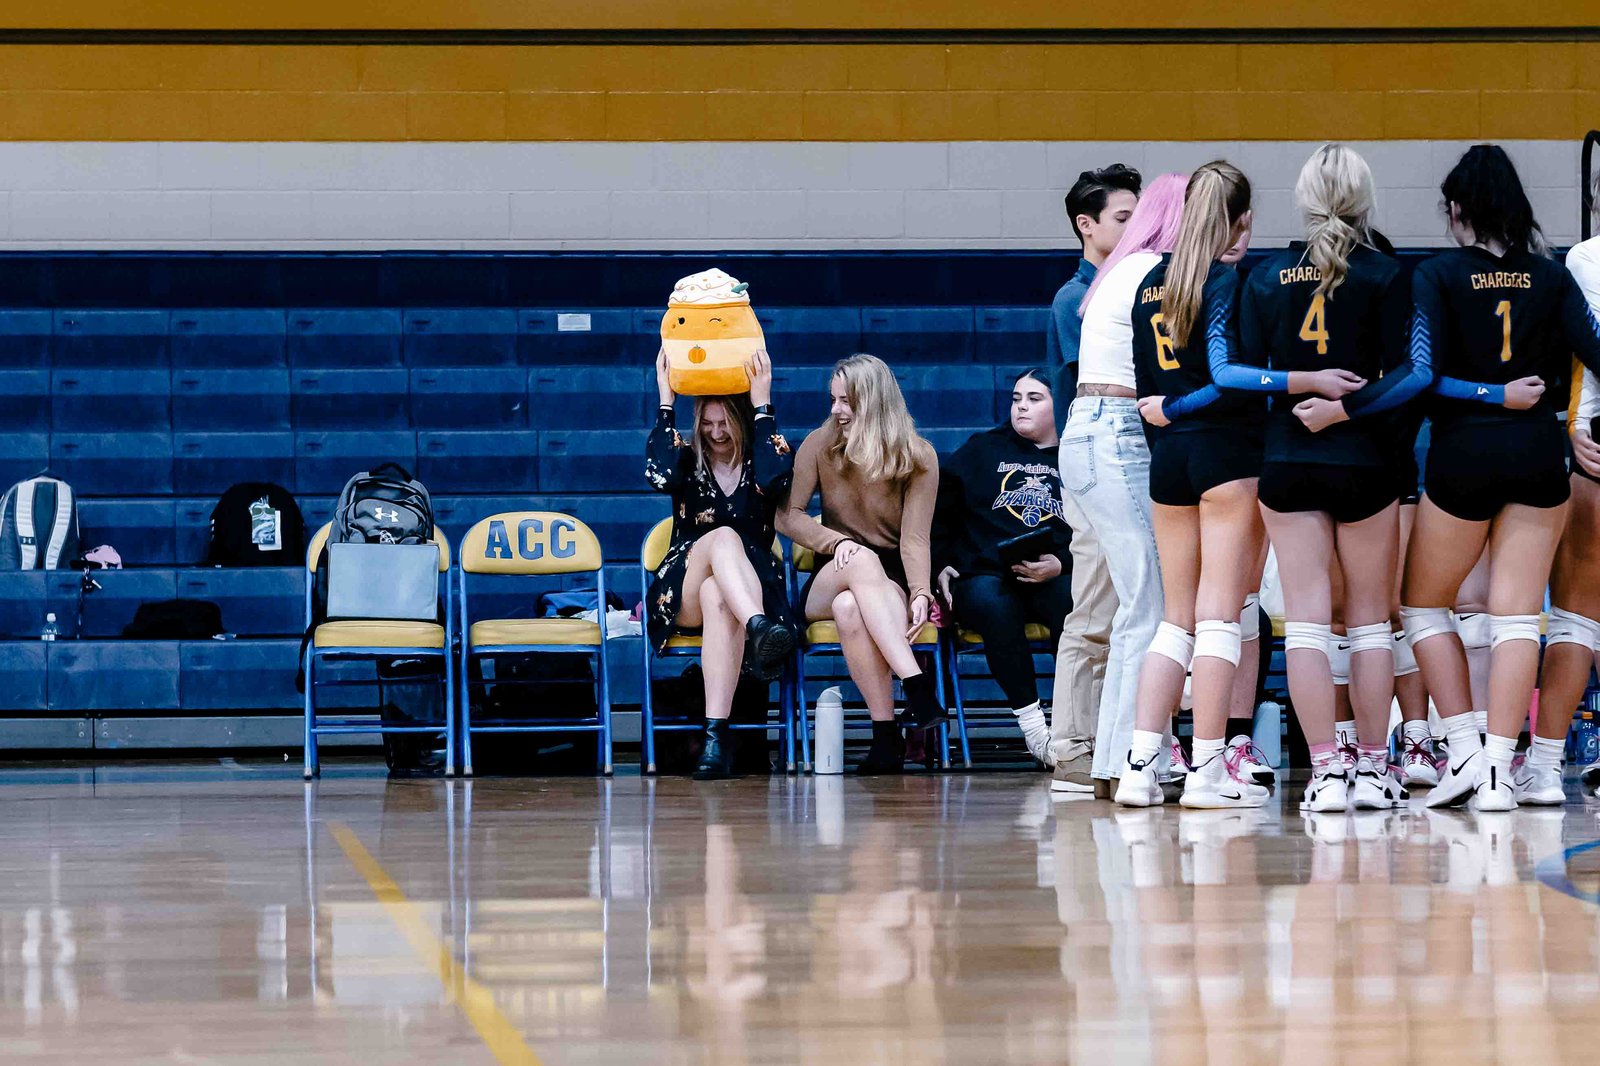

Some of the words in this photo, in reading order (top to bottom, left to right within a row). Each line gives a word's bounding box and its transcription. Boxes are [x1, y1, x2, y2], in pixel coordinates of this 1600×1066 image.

[1141, 286, 1165, 304] CHAR
[1279, 266, 1321, 285] CHARG
[1299, 292, 1330, 355] 4
[1495, 300, 1512, 362] 1
[484, 518, 576, 560] ACC
